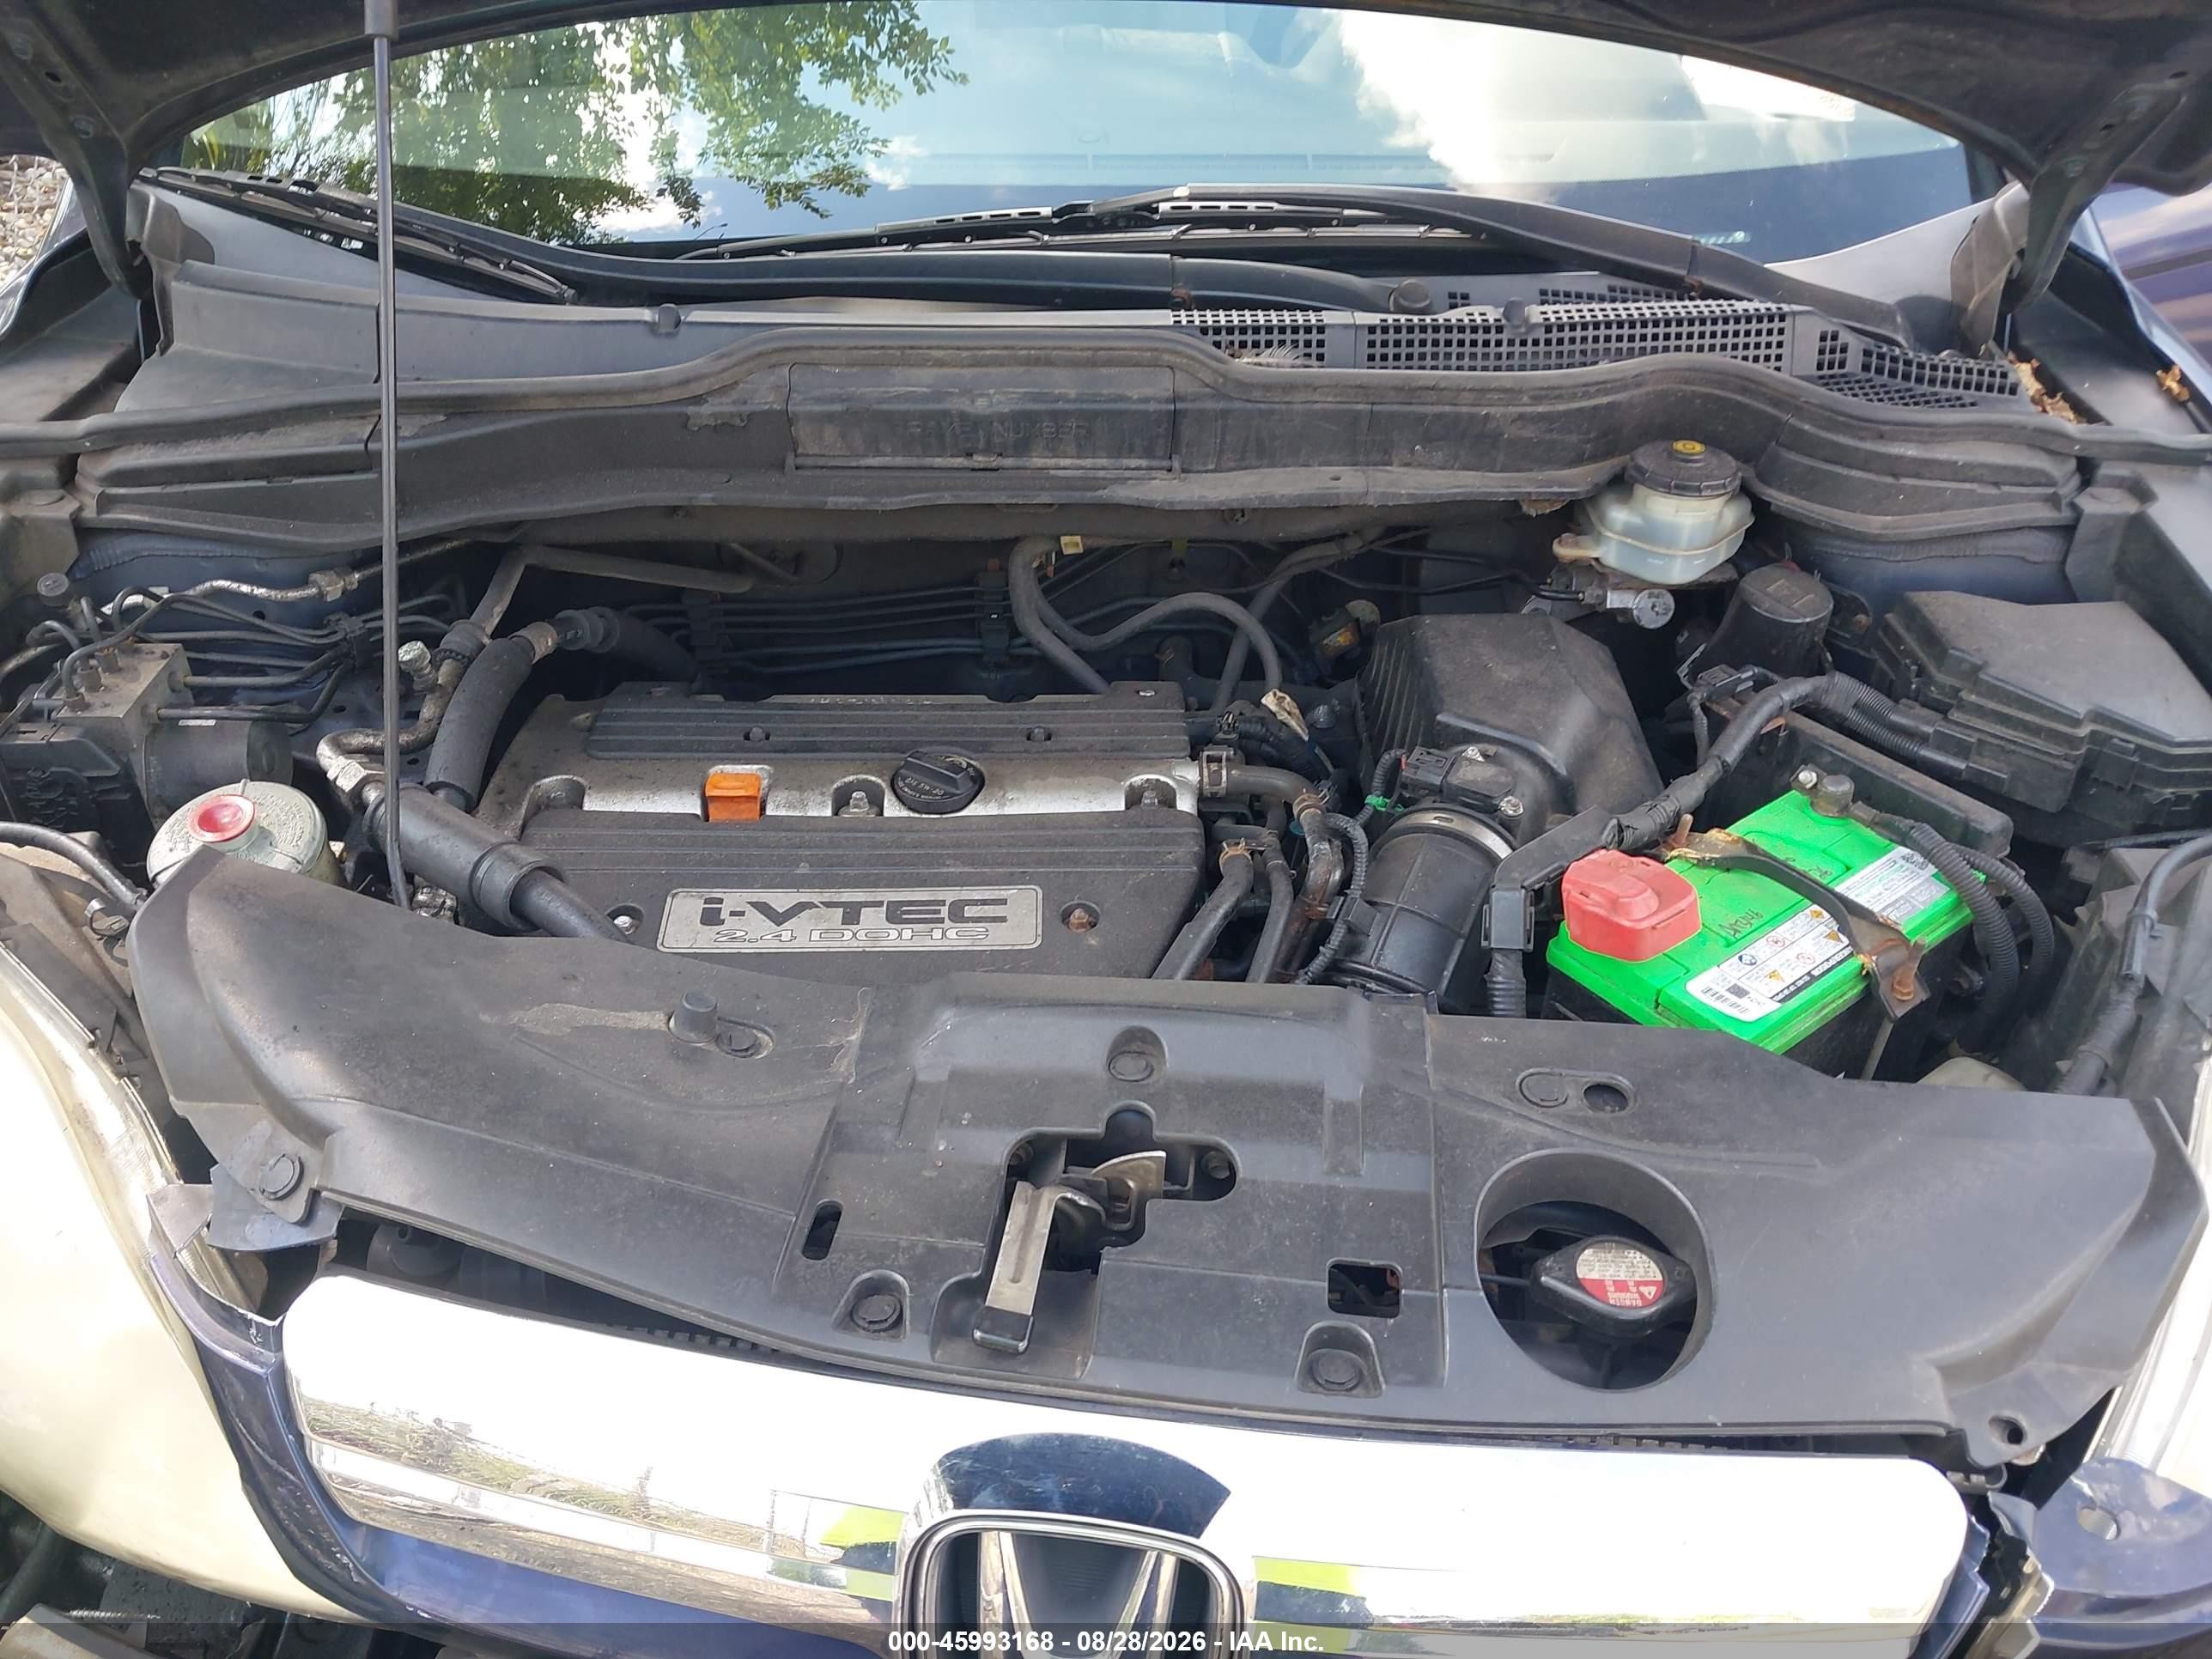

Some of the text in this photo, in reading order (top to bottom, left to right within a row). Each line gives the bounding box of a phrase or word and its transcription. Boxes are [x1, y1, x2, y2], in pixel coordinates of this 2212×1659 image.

[699, 896, 1008, 927] i-VTEC
[714, 927, 990, 943] 2.4 DOHC
